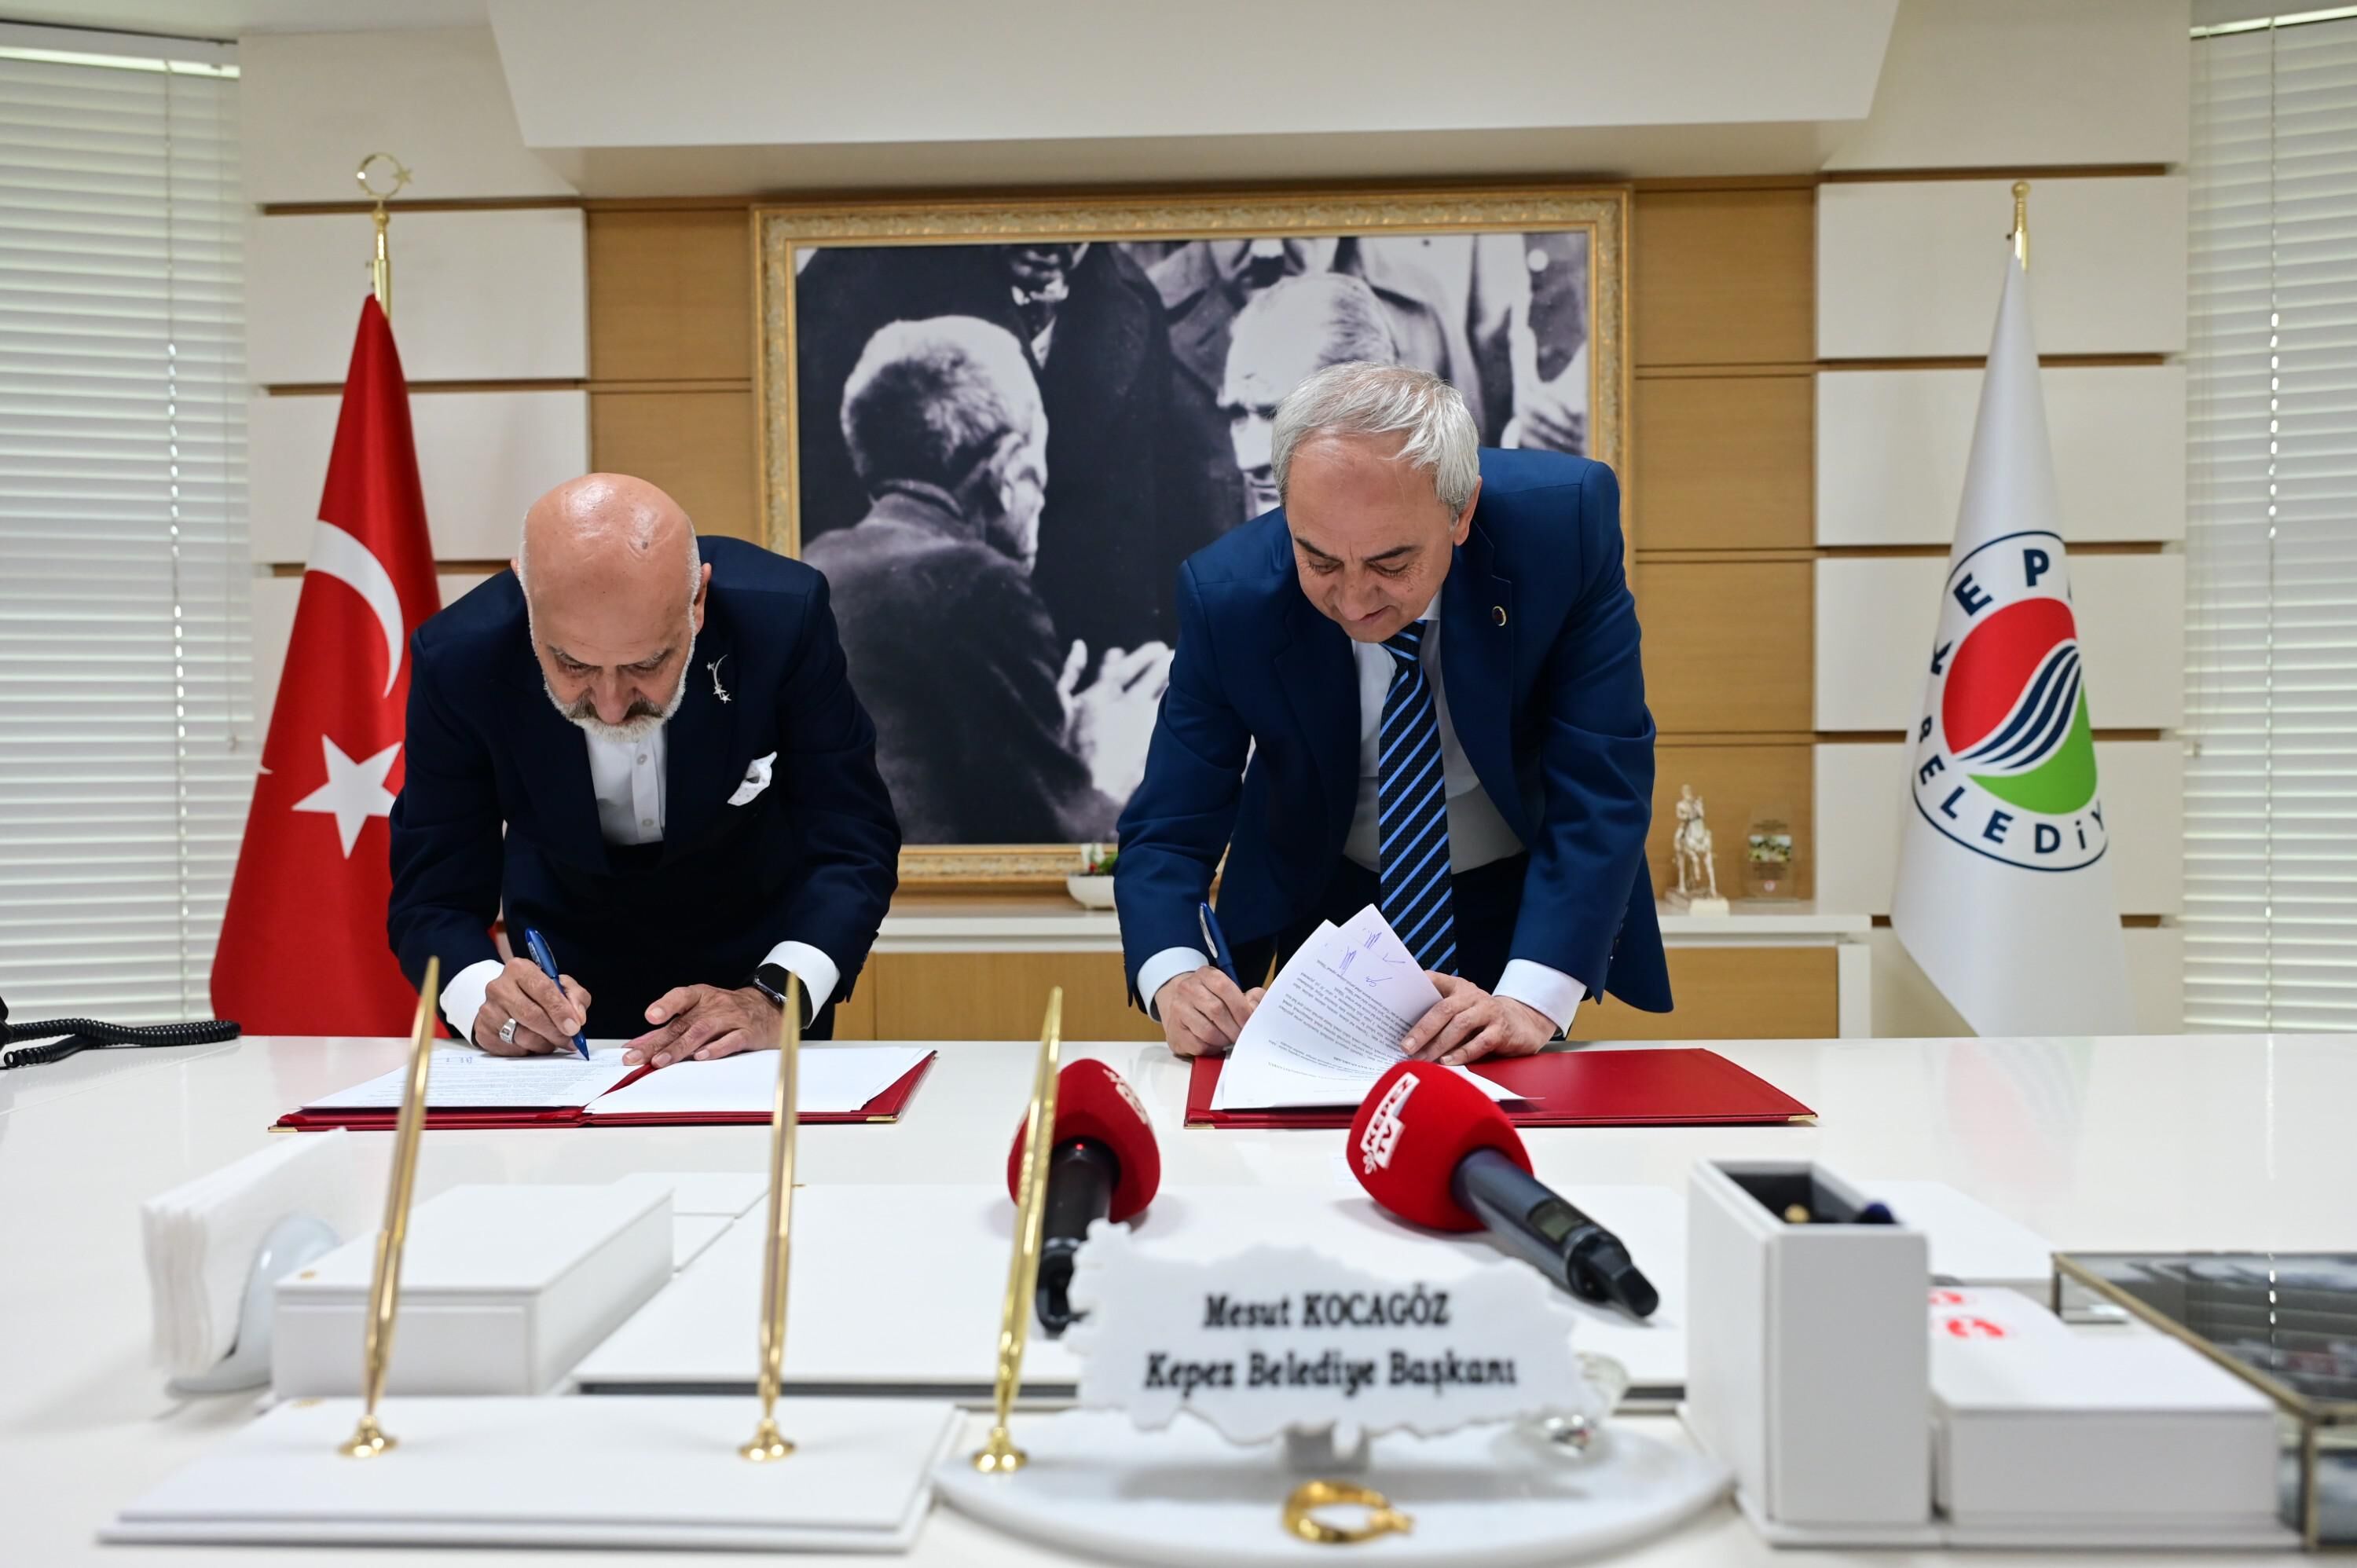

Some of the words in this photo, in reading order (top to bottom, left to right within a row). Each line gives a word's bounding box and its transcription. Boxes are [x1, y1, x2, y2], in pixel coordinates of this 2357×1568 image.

[1366, 1079, 1413, 1147] KEPEZ
[1376, 1123, 1392, 1154] TV
[1202, 1293, 1291, 1328] Mesut
[1301, 1284, 1450, 1328] KOCAGÖZ
[1144, 1353, 1235, 1397] Kepez
[1246, 1350, 1376, 1396] Belediye
[1387, 1350, 1517, 1394] Başkanı
